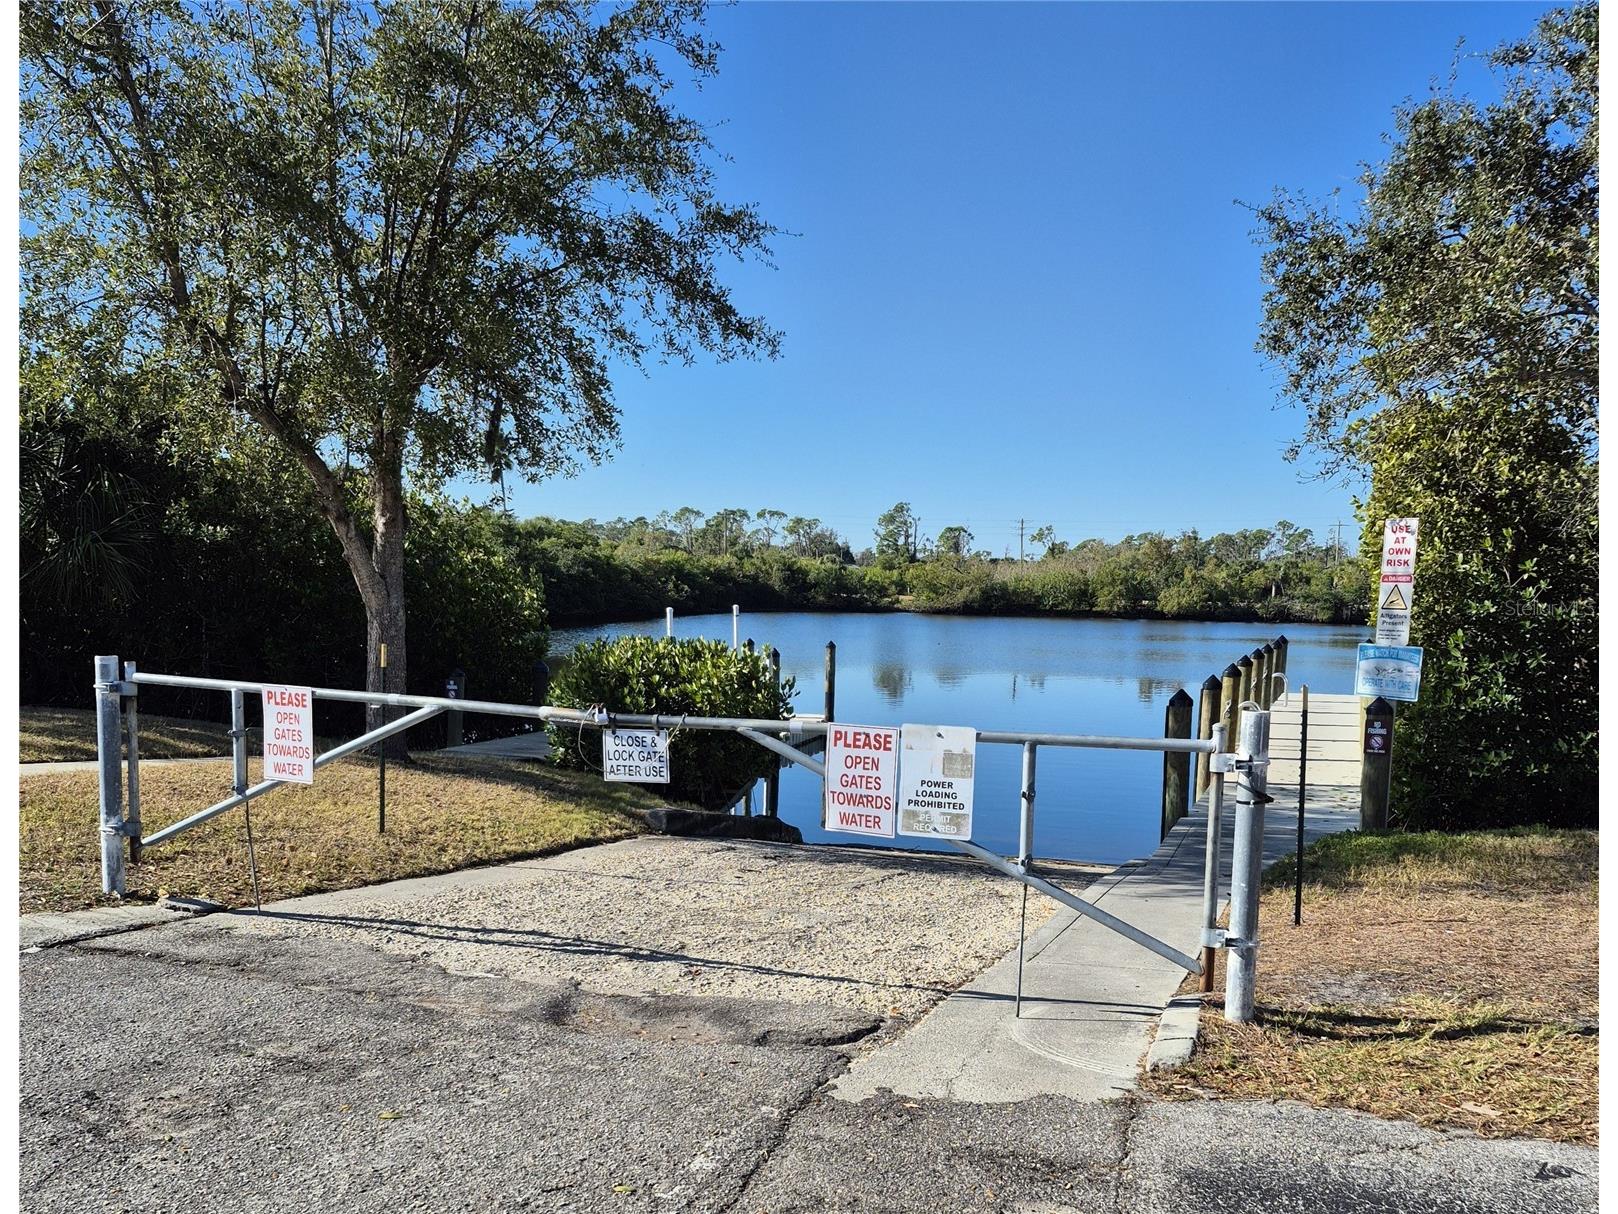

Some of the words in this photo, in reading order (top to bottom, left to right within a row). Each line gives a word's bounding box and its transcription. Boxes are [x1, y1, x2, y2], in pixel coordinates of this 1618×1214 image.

[1392, 524, 1411, 534] USE
[267, 690, 307, 708] PLEASE
[276, 712, 300, 724] OPEN
[274, 728, 302, 742] GATES
[614, 735, 647, 748] CLOSE
[650, 736, 657, 748] &
[834, 730, 892, 752] PLEASE
[267, 744, 310, 760] TOWARDS
[608, 750, 635, 760] LOCK
[638, 751, 664, 762] GATE
[274, 762, 304, 776] WATER
[844, 754, 880, 771] OPEN
[609, 764, 642, 776] AFTER
[644, 766, 664, 778] USE
[840, 774, 882, 790] GATES
[920, 780, 954, 789] POWER
[830, 791, 892, 810] TOWARDS
[916, 790, 958, 800] LOADING
[908, 799, 964, 810] PROHIBITED
[839, 812, 882, 829] WATER
